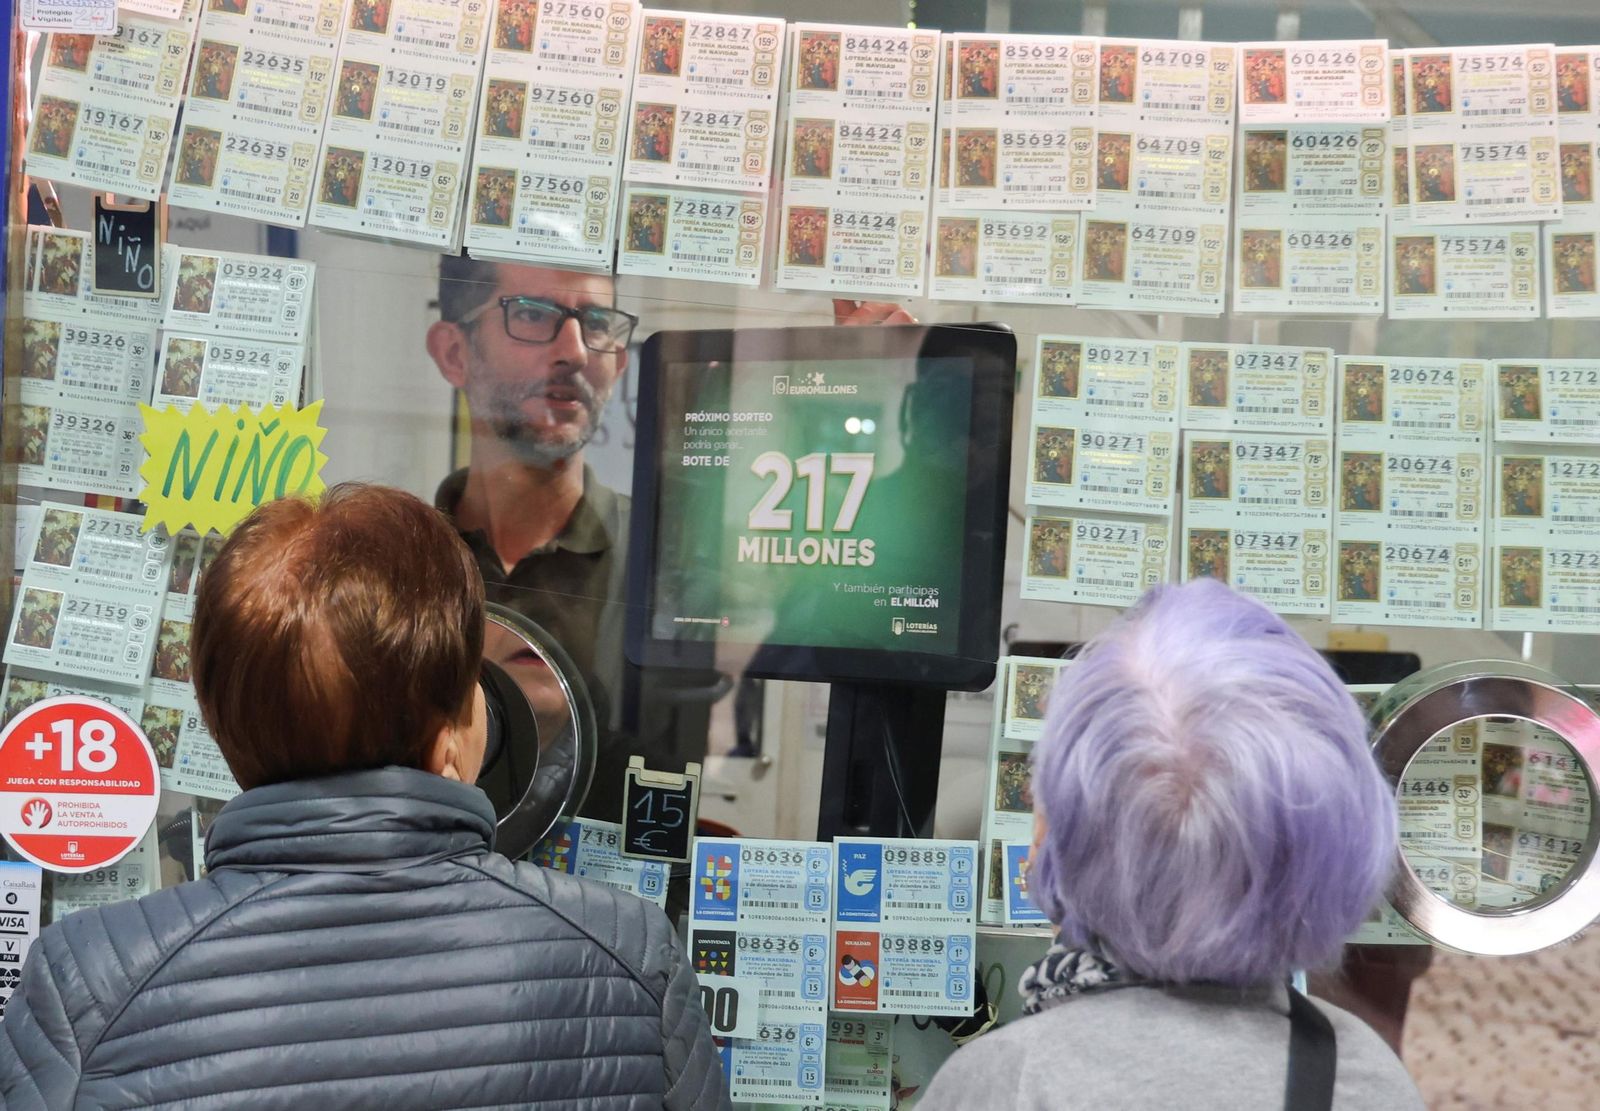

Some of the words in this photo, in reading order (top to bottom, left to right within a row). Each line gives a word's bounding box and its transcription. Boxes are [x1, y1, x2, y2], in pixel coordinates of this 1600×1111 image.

[543, 2, 604, 19] 97560
[689, 24, 751, 40] 72847
[846, 38, 909, 52] 84424
[1005, 45, 1069, 60] 85692
[1142, 51, 1205, 65] 64709
[1291, 52, 1356, 66] 60426
[243, 51, 303, 71] 22635
[1459, 58, 1523, 70] 75574
[386, 70, 446, 90] 12019
[757, 70, 768, 80] 20
[163, 79, 173, 88] 20
[916, 83, 926, 92] 20
[532, 88, 593, 106] 97560
[306, 105, 316, 114] 20
[83, 109, 143, 134] 19167
[680, 110, 743, 127] 72847
[840, 126, 902, 140] 84424
[1003, 133, 1066, 147] 85692
[225, 137, 286, 158] 22635
[599, 137, 609, 146] 20
[1137, 138, 1200, 154] 64709
[1292, 135, 1358, 149] 60426
[1462, 146, 1527, 159] 75574
[145, 164, 154, 174] 20
[372, 157, 431, 176] 12019
[748, 158, 759, 167] 20
[910, 171, 920, 181] 20
[521, 175, 583, 193] 97560
[1367, 179, 1378, 189] 20
[434, 210, 444, 220] 20
[674, 201, 735, 217] 72847
[833, 214, 896, 229] 84424
[589, 225, 599, 235] 20
[984, 224, 1047, 239] 85692
[1131, 227, 1196, 243] 64709
[1288, 234, 1353, 248] 60426
[1442, 239, 1506, 252] 75574
[742, 249, 753, 259] 20
[904, 259, 914, 268] 20
[223, 263, 282, 281] 05924
[285, 309, 296, 318] 20
[64, 329, 125, 347] 39326
[210, 346, 271, 364] 05924
[1087, 348, 1149, 363] 90271
[1235, 354, 1298, 368] 07347
[1390, 368, 1454, 382] 20674
[789, 384, 858, 395] EUROMILLONES
[53, 413, 115, 432] 39326
[685, 411, 730, 422] PRÓXIMO
[733, 412, 773, 422] SORTEO
[1081, 434, 1143, 449] 90271
[1236, 445, 1299, 459] 07347
[683, 456, 711, 466] BOTE
[714, 456, 730, 466] DE
[1388, 458, 1452, 471] 20674
[120, 464, 130, 473] 20
[748, 450, 875, 532] 217
[1152, 481, 1162, 490] 20
[1462, 504, 1473, 512] 20
[1076, 525, 1138, 541] 90271
[1235, 534, 1298, 547] 07347
[737, 536, 875, 567] MILLONES
[1386, 547, 1449, 560] 20674
[833, 583, 841, 591] Y
[844, 582, 884, 594] también
[888, 585, 939, 597] participas
[874, 599, 887, 607] en
[891, 597, 901, 607] EL
[904, 594, 938, 608] MILLÓN
[67, 600, 128, 620] 27159
[906, 621, 937, 631] LOTERÍAS
[128, 649, 139, 658] 20
[25, 718, 118, 773] +18
[59, 778, 141, 788] RESPONSABILIDAD
[57, 801, 100, 810] PROHIBIDA
[634, 790, 686, 827] 15
[67, 811, 95, 819] VENTA
[57, 820, 128, 829] AUTOPROHIBIDOS
[632, 830, 668, 852] €
[1518, 834, 1582, 855] 61412
[742, 850, 803, 864] 08636
[885, 850, 946, 863] 09889
[3, 880, 36, 889] CaixaBank
[647, 879, 656, 888] 15
[812, 895, 821, 903] 15
[956, 895, 965, 903] 15
[0, 917, 25, 928] VISA
[738, 937, 799, 951] 08636
[882, 938, 944, 952] 09889
[808, 984, 818, 992] 15
[953, 984, 963, 992] 15
